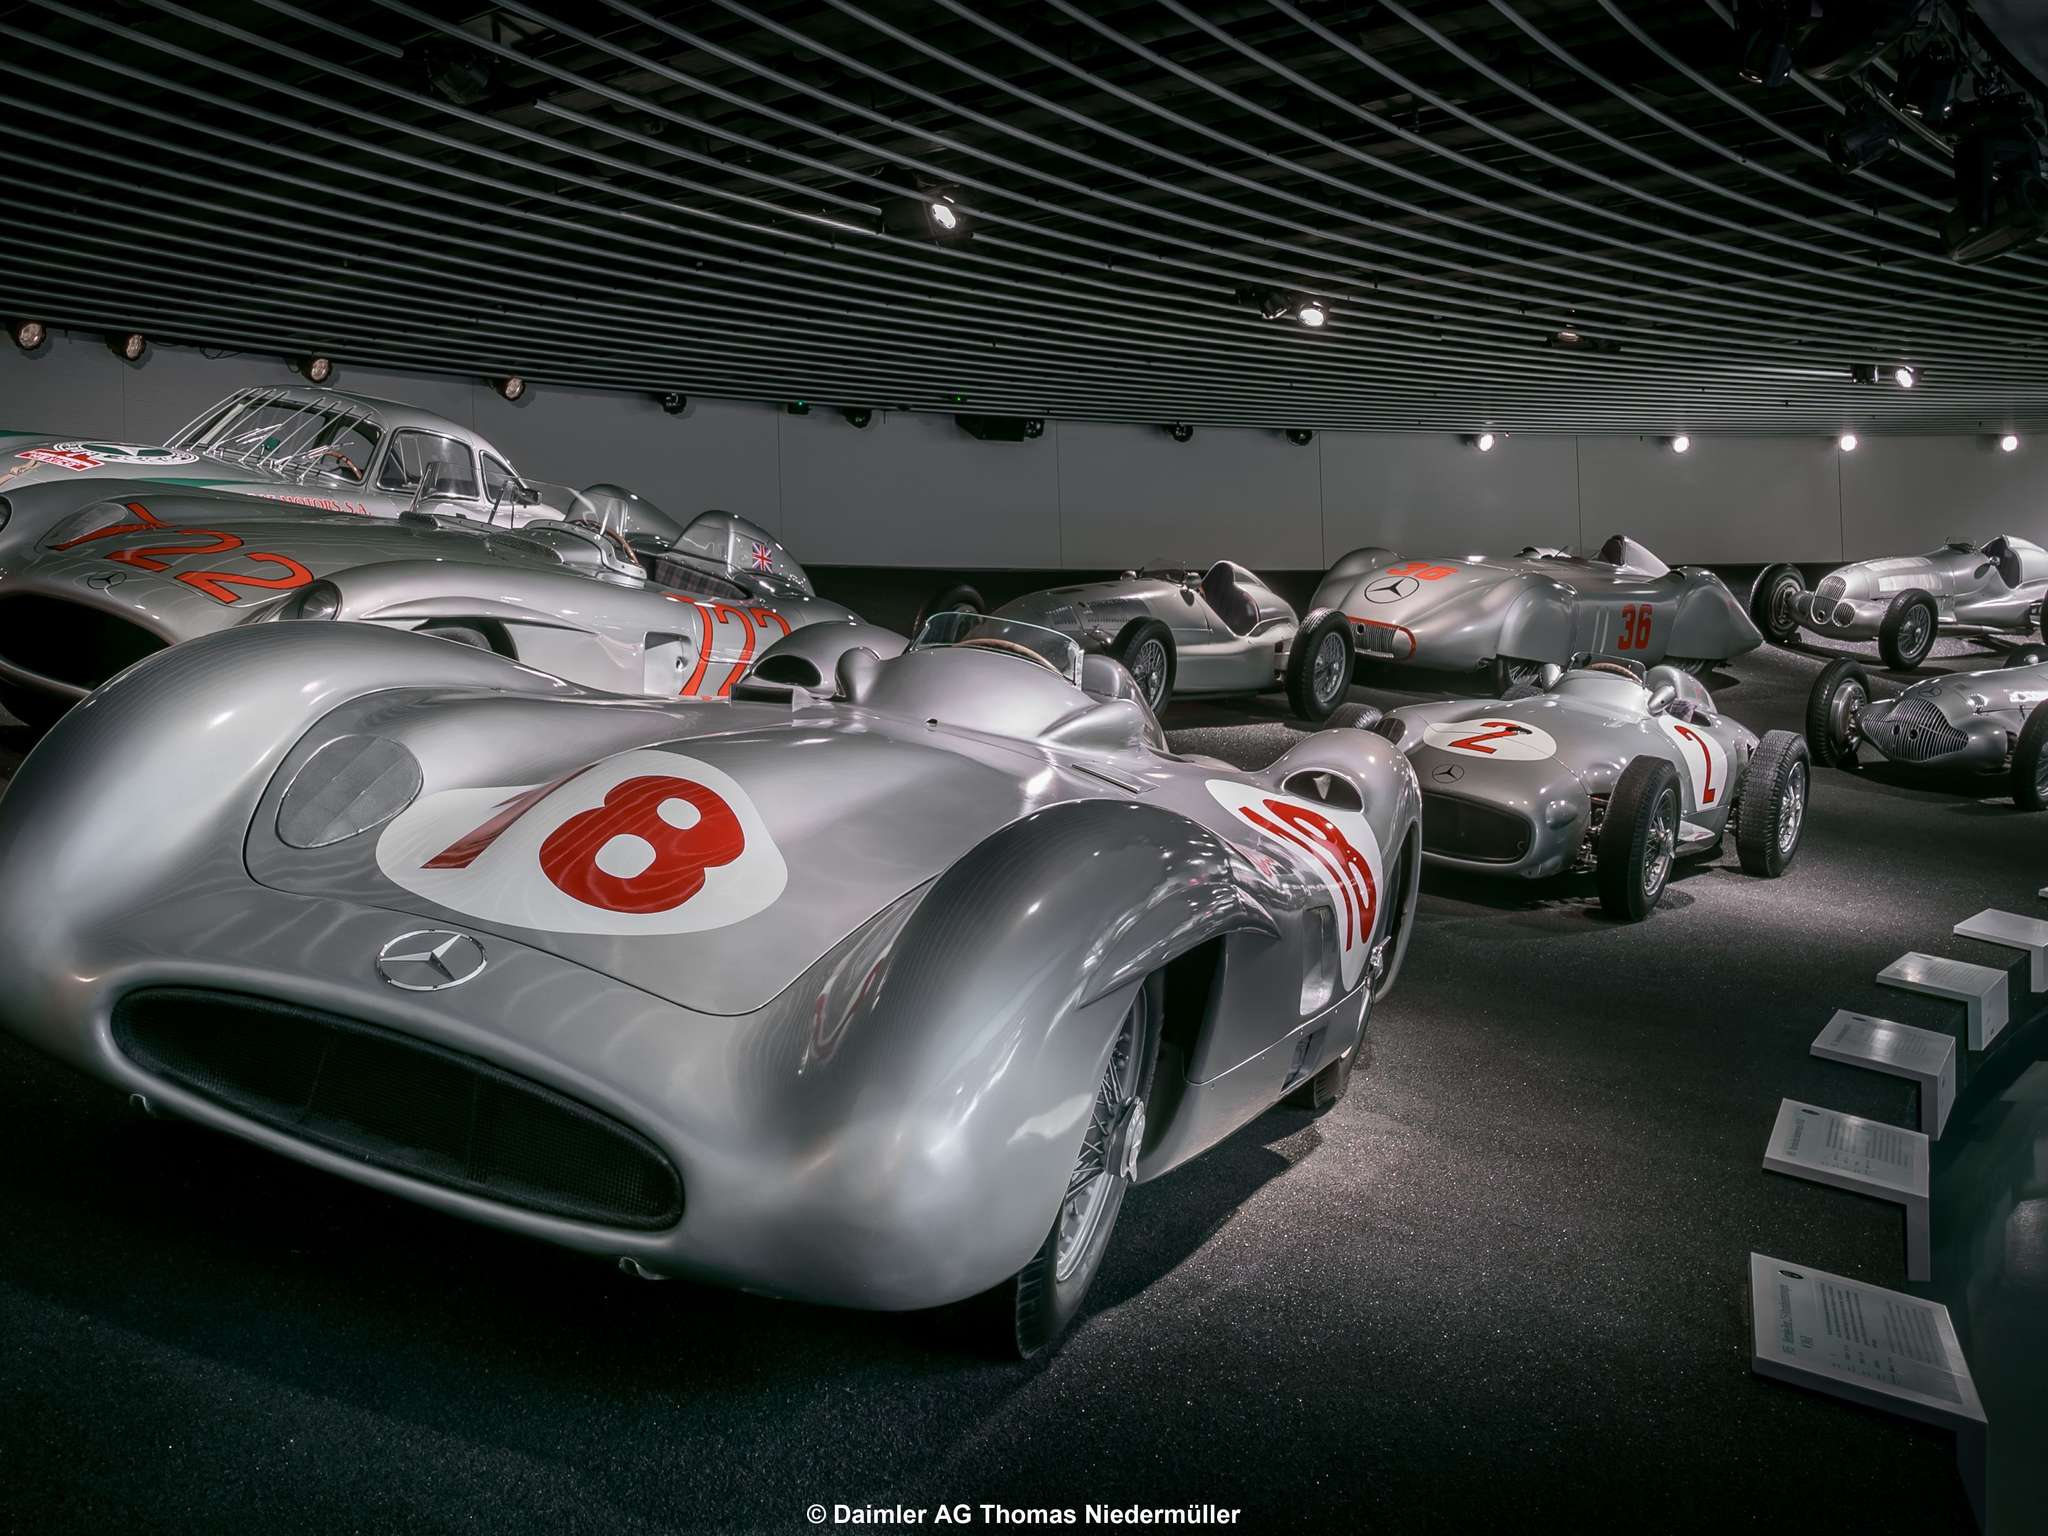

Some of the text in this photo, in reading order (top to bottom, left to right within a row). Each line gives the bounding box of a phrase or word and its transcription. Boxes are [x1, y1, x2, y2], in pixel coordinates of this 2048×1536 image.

[1387, 562, 1458, 581] 36
[1618, 603, 1654, 650] 36
[1448, 721, 1522, 755] 2
[1673, 725, 1716, 804] 2
[420, 762, 746, 914] 18
[1238, 799, 1377, 952] 18
